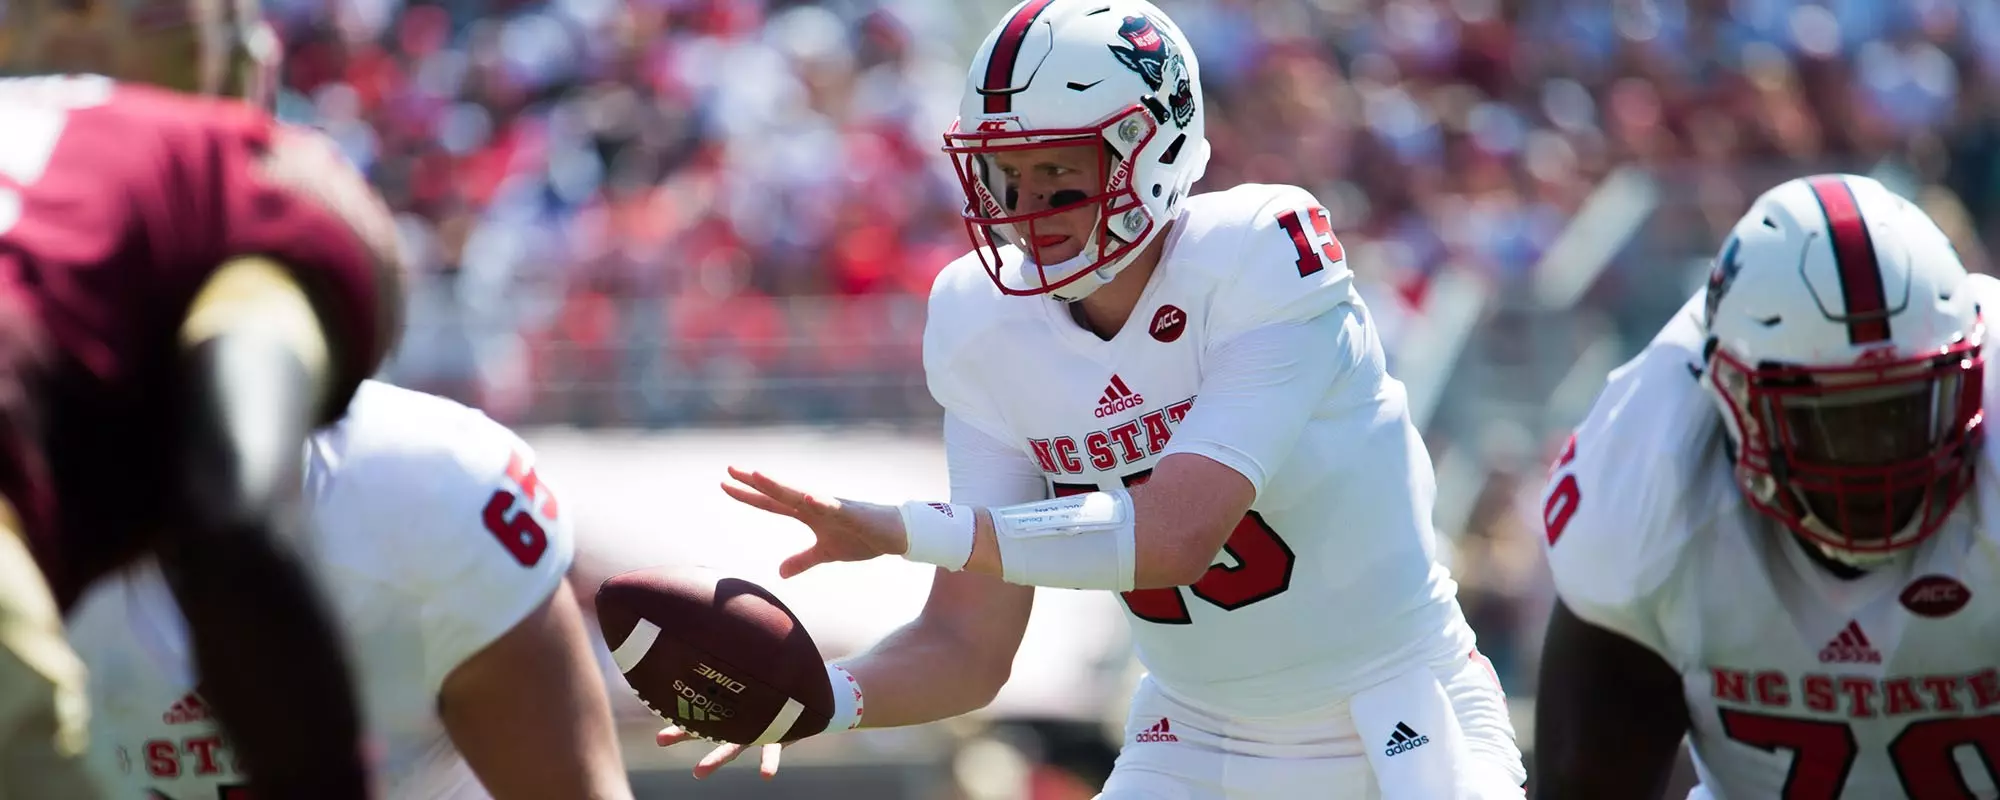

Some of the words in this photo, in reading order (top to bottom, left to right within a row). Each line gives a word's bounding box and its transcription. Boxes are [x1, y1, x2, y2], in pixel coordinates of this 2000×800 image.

[976, 120, 1007, 132] ACC
[1108, 160, 1130, 192] ddell
[1274, 206, 1343, 278] 15
[1154, 309, 1180, 333] ACC
[1094, 393, 1144, 418] adidas
[1027, 436, 1084, 475] NC
[1084, 394, 1198, 471] STAT
[482, 446, 558, 569] 65
[692, 662, 747, 694] DIME
[1711, 667, 1791, 706] NC
[1803, 667, 2000, 718] STATE
[672, 679, 736, 718] adidas
[1136, 731, 1178, 743] adidas
[1385, 735, 1430, 757] adidas
